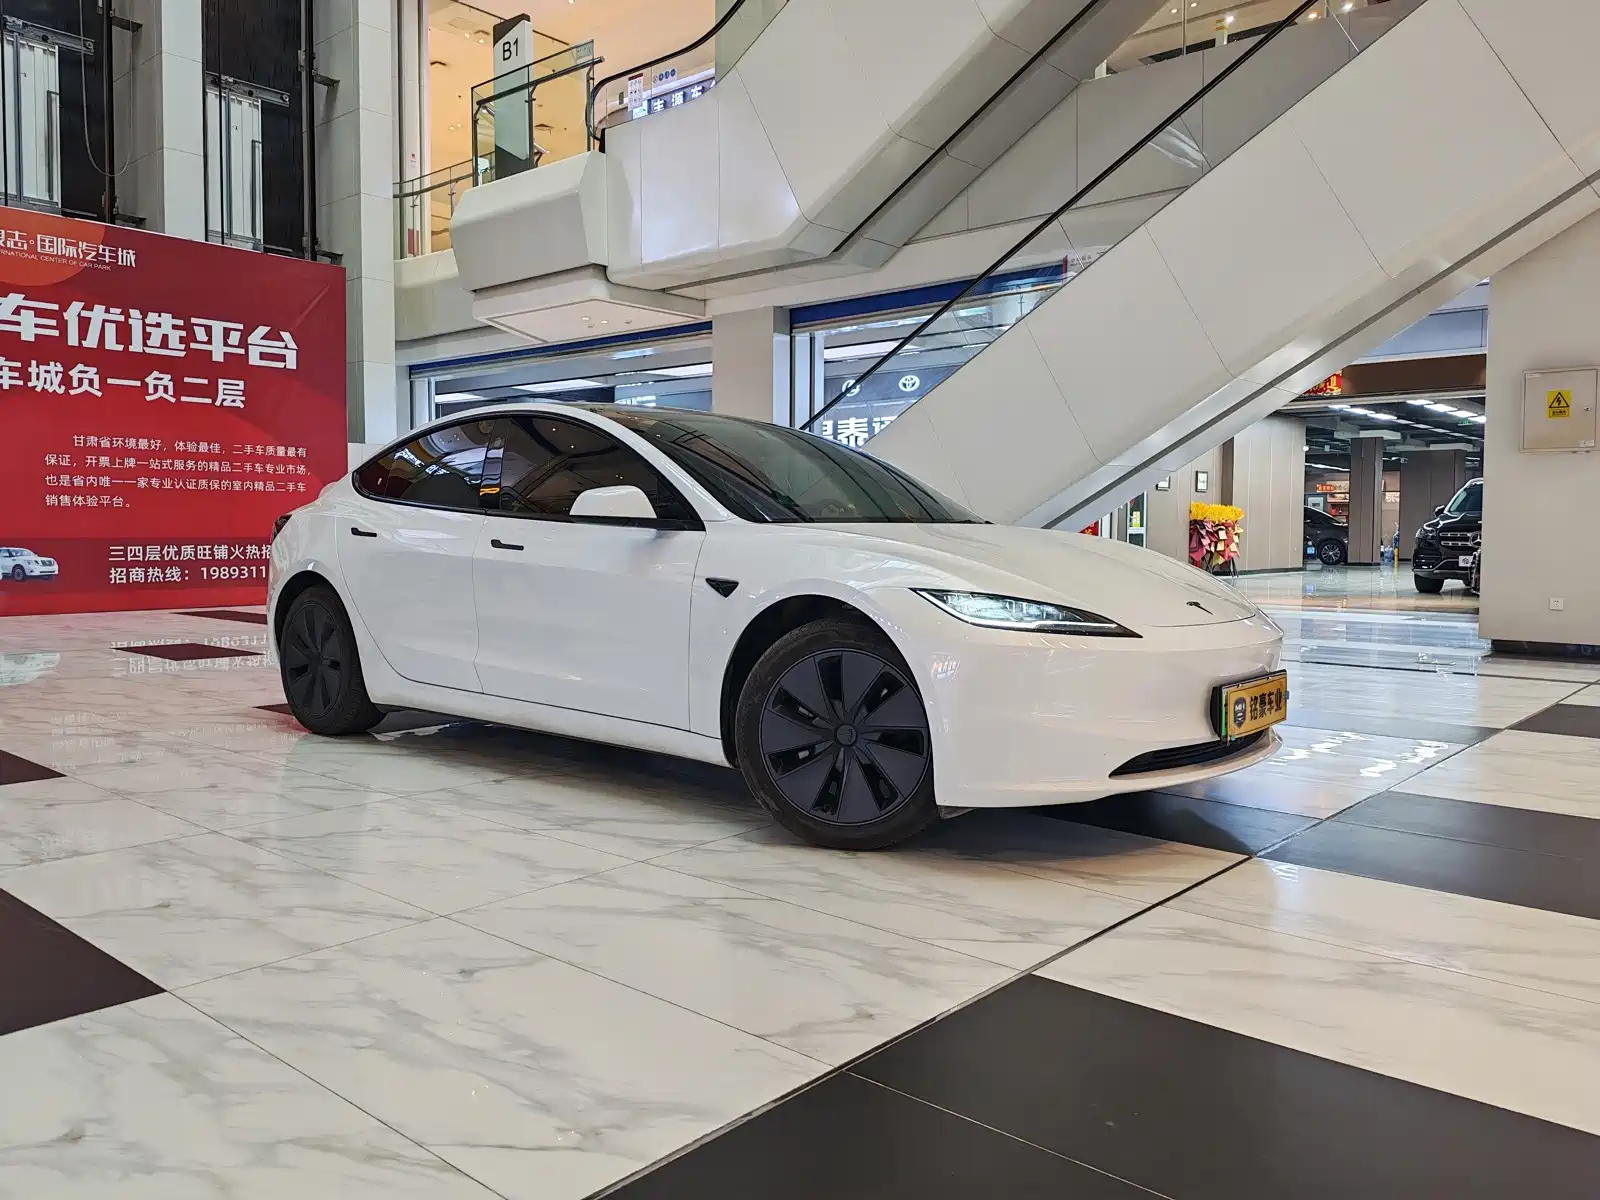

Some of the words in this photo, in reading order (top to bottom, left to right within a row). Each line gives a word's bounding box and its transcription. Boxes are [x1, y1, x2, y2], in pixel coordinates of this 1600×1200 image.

[502, 37, 519, 62] B1
[40, 254, 68, 265] CENTER
[79, 261, 94, 269] CAR
[94, 263, 112, 271] PARK
[0, 292, 299, 370] 车优选平台
[0, 357, 246, 408] 车城负一负二层
[44, 474, 307, 493] 也是省内唯一一家专业认证质保的室内精品二手车
